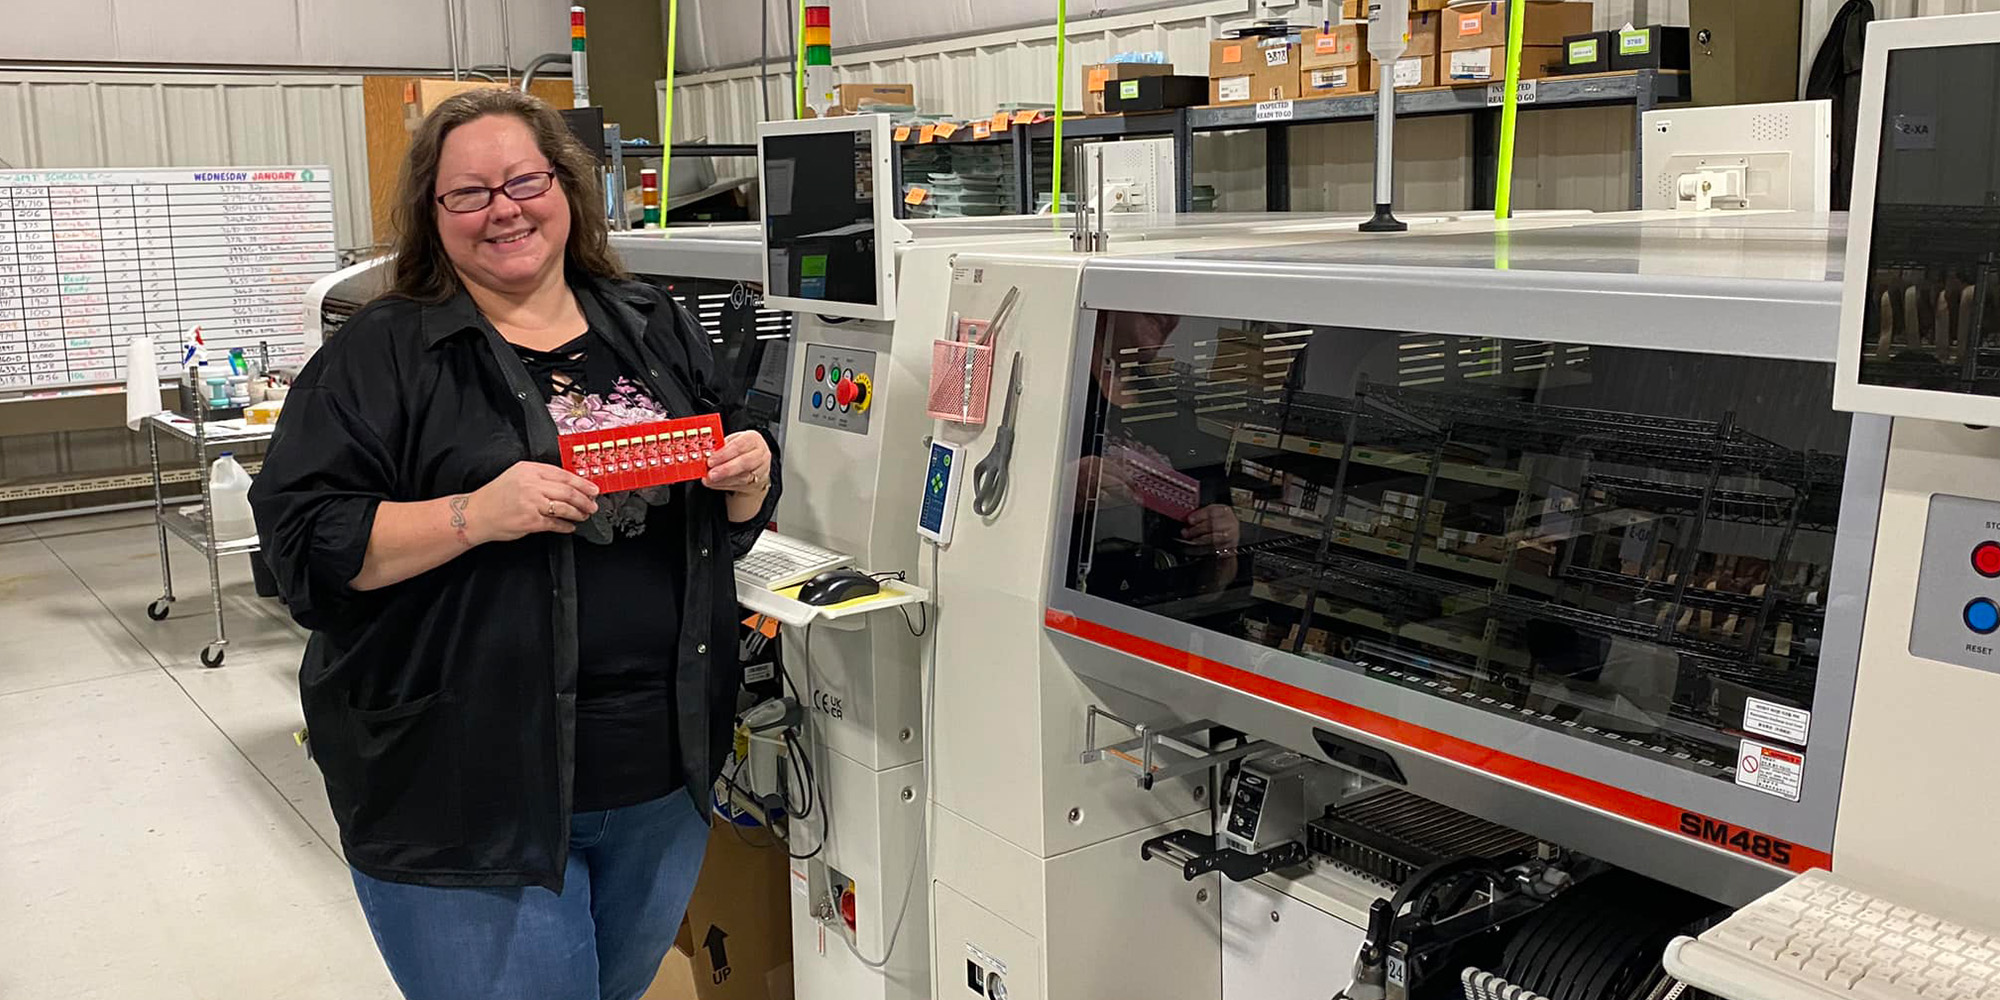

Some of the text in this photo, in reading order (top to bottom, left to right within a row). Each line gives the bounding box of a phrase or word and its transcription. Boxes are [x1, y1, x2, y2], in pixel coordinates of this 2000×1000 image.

[1523, 93, 1535, 101] GO
[1259, 101, 1289, 110] INSPECTED
[194, 172, 296, 181] WEDNESDAY JANUARY
[1965, 643, 1993, 656] RESET
[830, 695, 842, 709] UK
[1679, 812, 1793, 865] SM485
[712, 967, 732, 985] UP
[1389, 959, 1403, 983] 24
